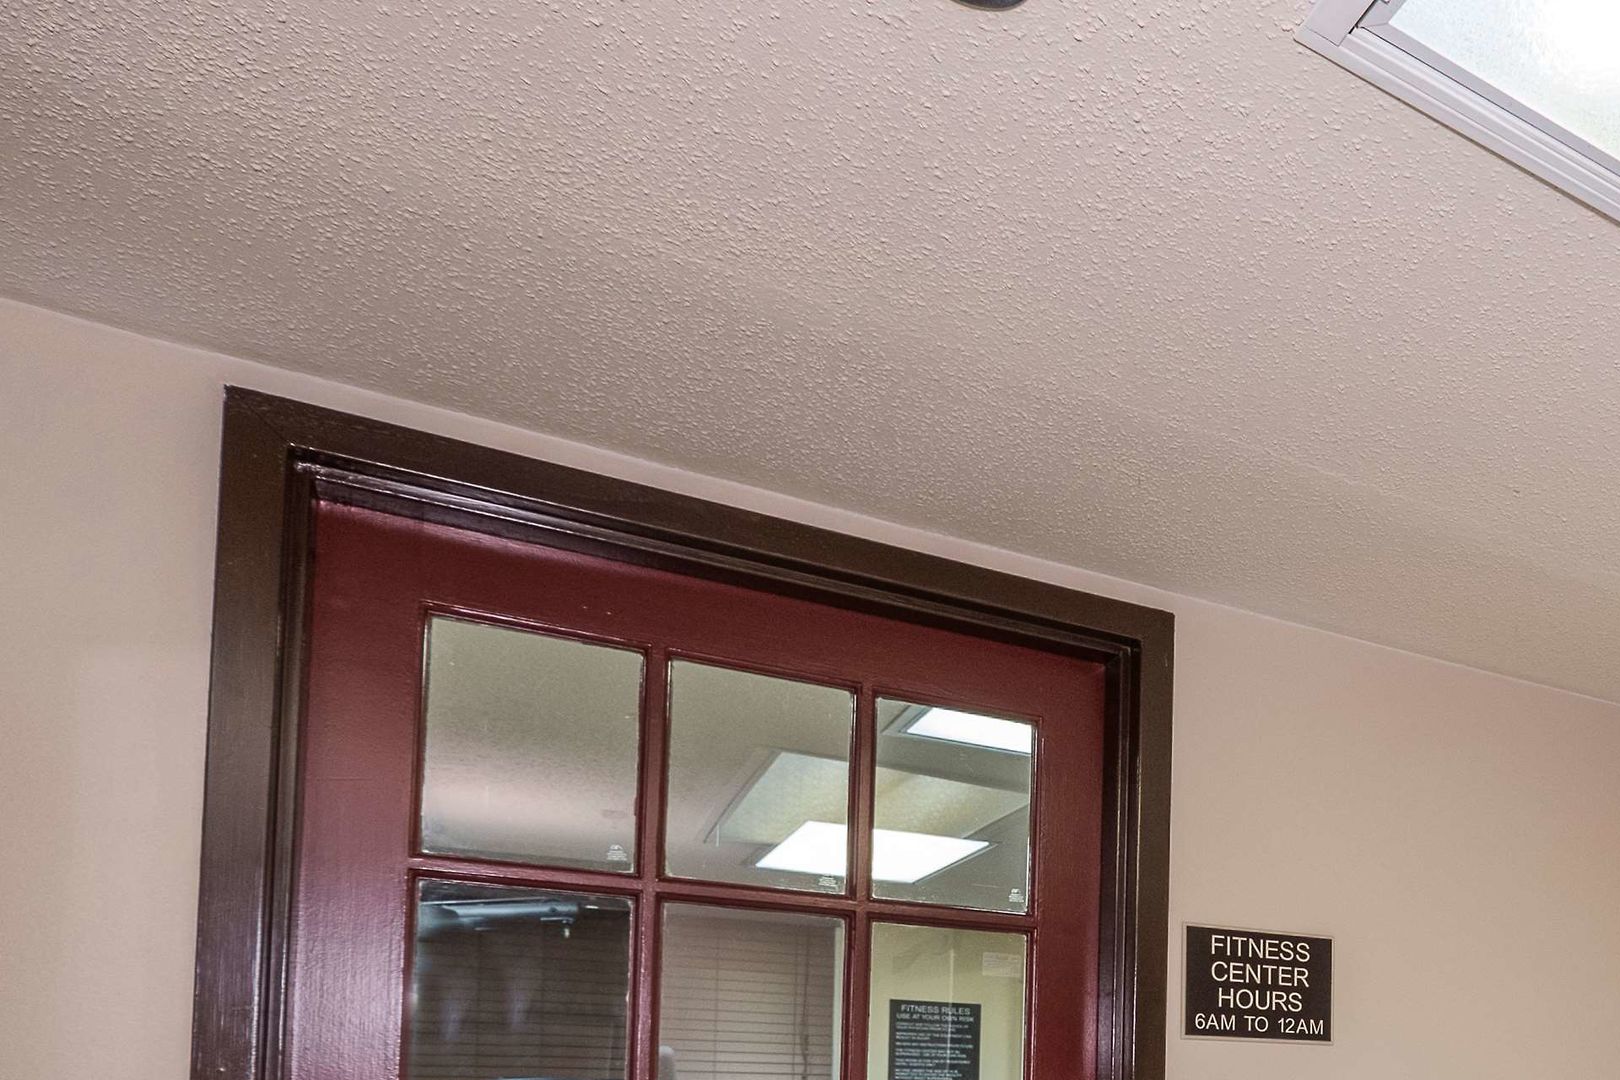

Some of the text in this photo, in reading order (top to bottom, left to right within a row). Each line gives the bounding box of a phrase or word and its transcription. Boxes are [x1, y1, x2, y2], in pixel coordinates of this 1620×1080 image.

[1211, 934, 1310, 962] FITNESS
[1211, 961, 1309, 987] CENTER
[901, 1004, 971, 1015] FITNESS RULES
[1218, 987, 1303, 1012] HOURS
[1195, 1013, 1324, 1035] 6AM TO 12AM
